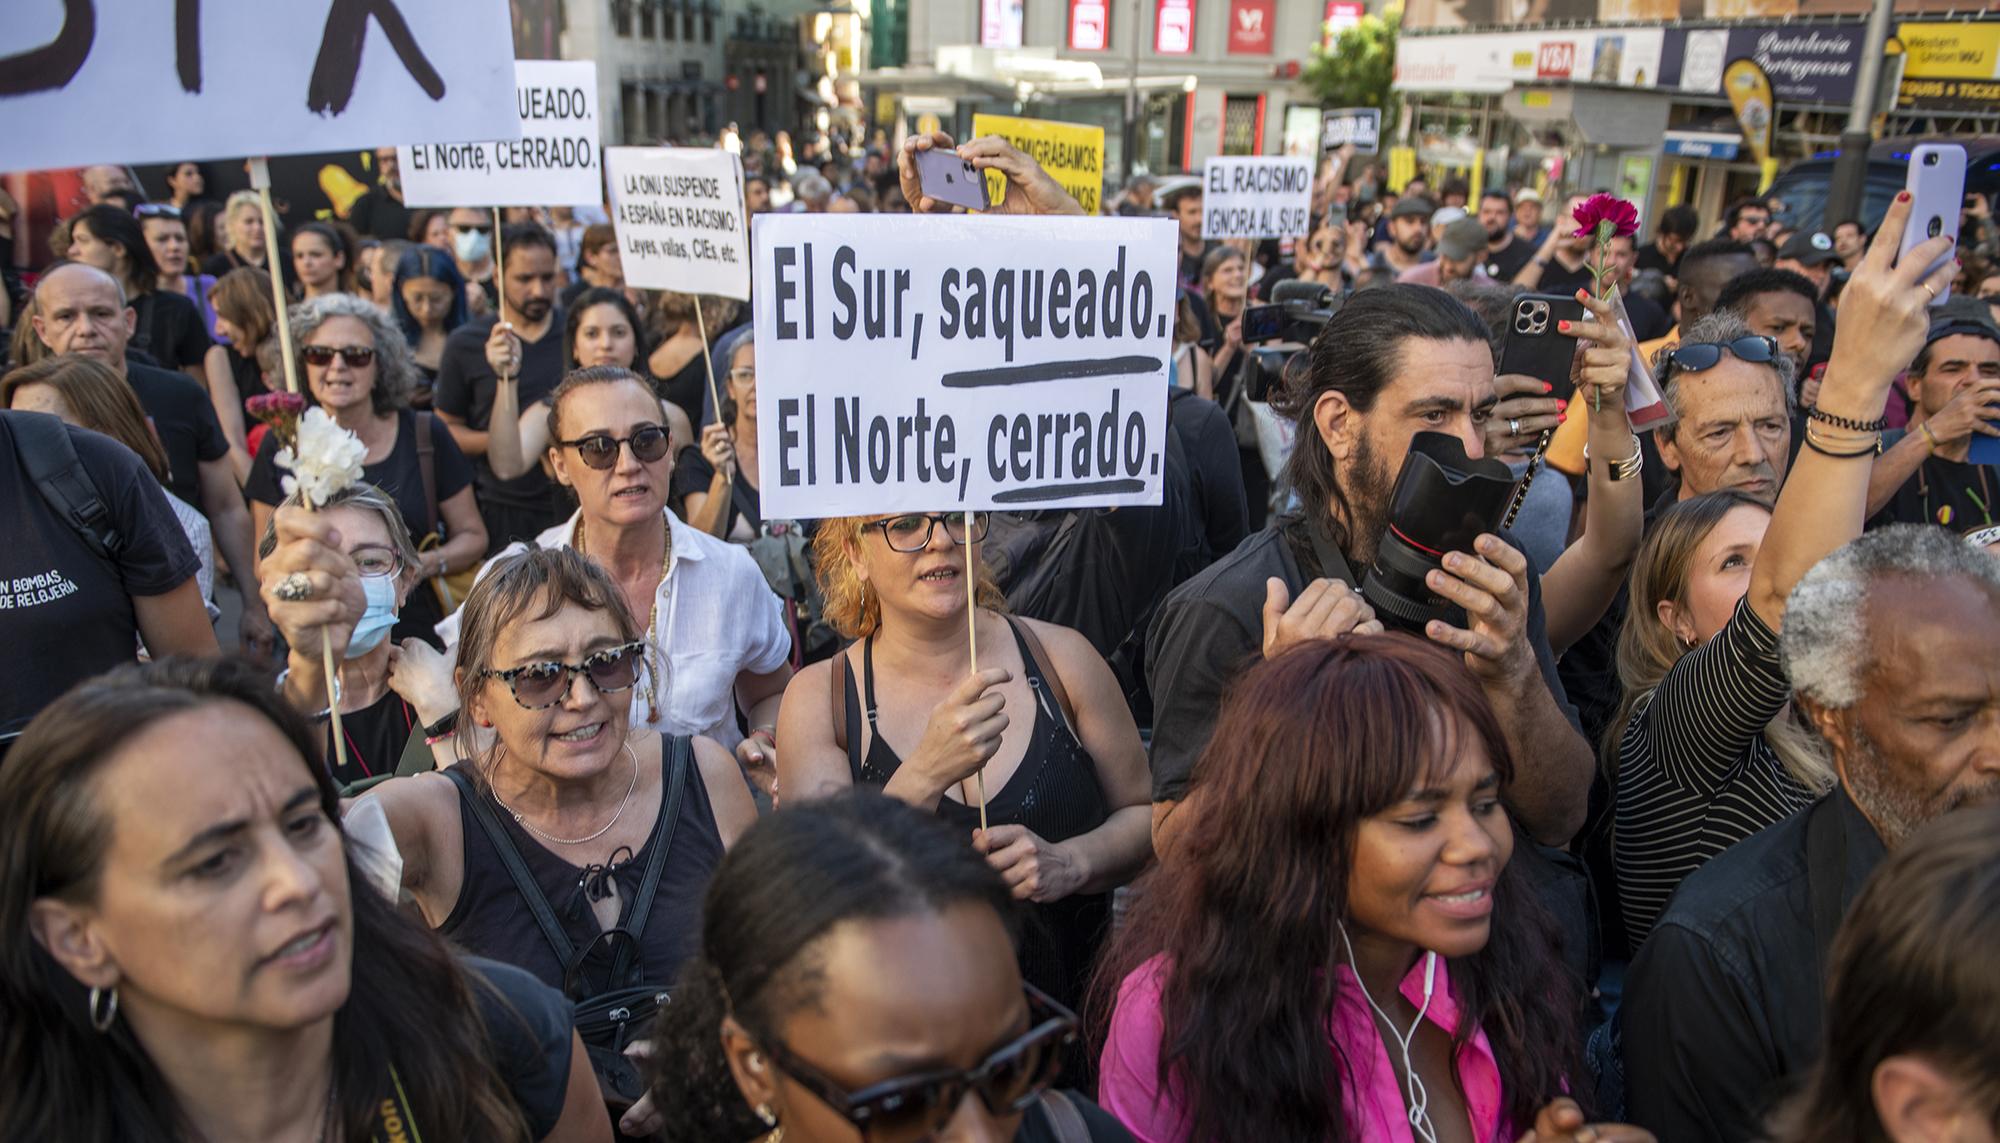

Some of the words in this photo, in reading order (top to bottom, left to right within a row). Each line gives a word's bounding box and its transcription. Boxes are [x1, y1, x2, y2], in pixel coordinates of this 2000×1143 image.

[518, 87, 591, 120] UEADO.
[436, 142, 490, 175] Norte,
[496, 137, 596, 169] CERRADO.
[624, 173, 639, 194] LA
[639, 174, 662, 196] ONU
[663, 175, 720, 200] SUSPENDE
[988, 176, 1004, 204] OY
[1209, 166, 1228, 193] EL
[1234, 166, 1309, 193] RACISMO
[620, 204, 627, 220] A
[627, 201, 668, 225] ESPAÑA
[669, 207, 684, 228] EN
[686, 207, 738, 233] RACISMO:
[1207, 208, 1256, 235] IGNORA
[1261, 209, 1275, 235] AL
[1279, 208, 1306, 235] SUR
[627, 235, 660, 260] Leyes,
[722, 244, 738, 264] etc.
[774, 242, 815, 340] El
[832, 245, 923, 360] Sur,
[940, 245, 1166, 362] saqueado.
[778, 394, 816, 487] El
[834, 396, 971, 502] Norte,
[987, 388, 1159, 482] cerrado.
[12, 569, 61, 593] BOMBAS
[16, 578, 79, 608] RELOJERÍA
